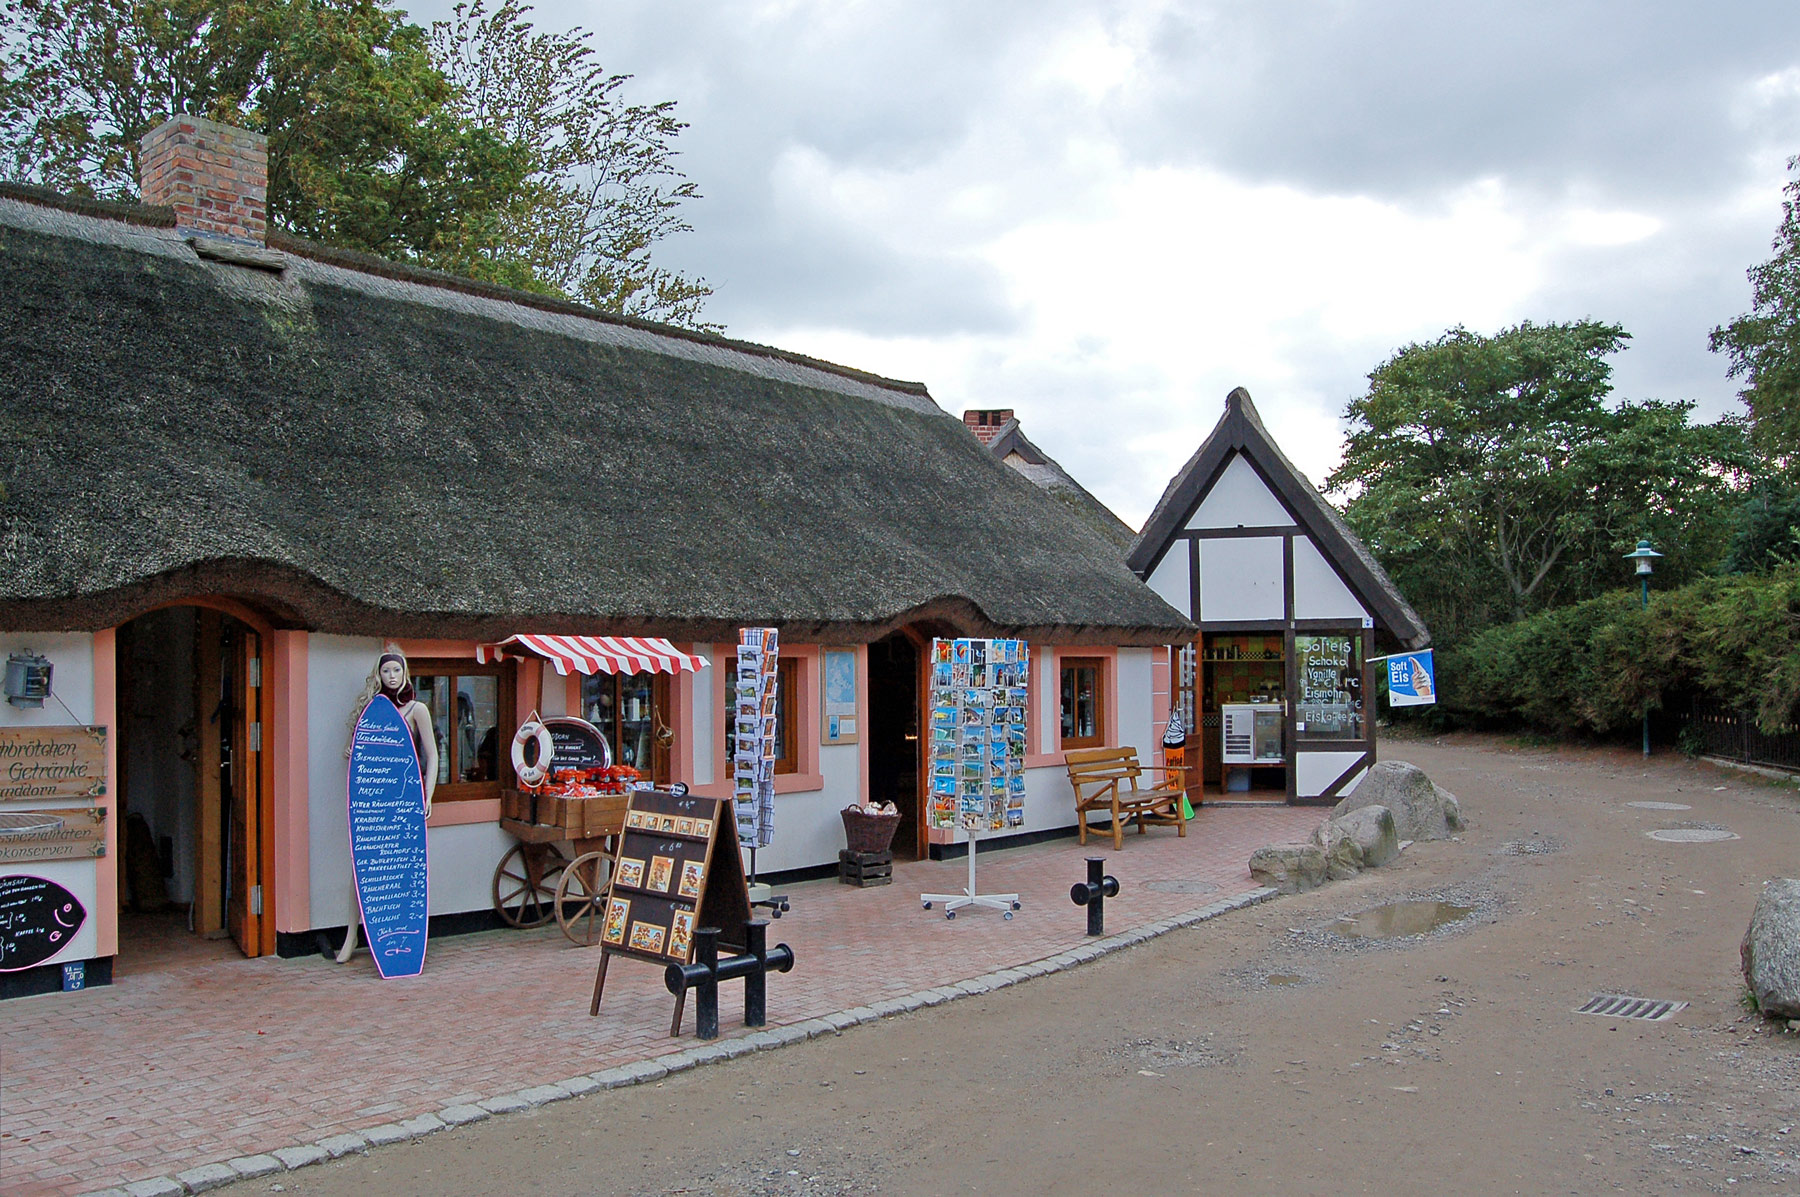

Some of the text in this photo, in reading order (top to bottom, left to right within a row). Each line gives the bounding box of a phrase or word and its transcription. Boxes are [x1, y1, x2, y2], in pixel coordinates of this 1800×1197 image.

[1309, 655, 1347, 668] Schoko
[1390, 661, 1408, 671] Soft
[1307, 667, 1337, 679] Vanille
[1391, 671, 1409, 683] Eis
[1305, 687, 1344, 699] Eismohr
[9, 760, 88, 781] Getränke
